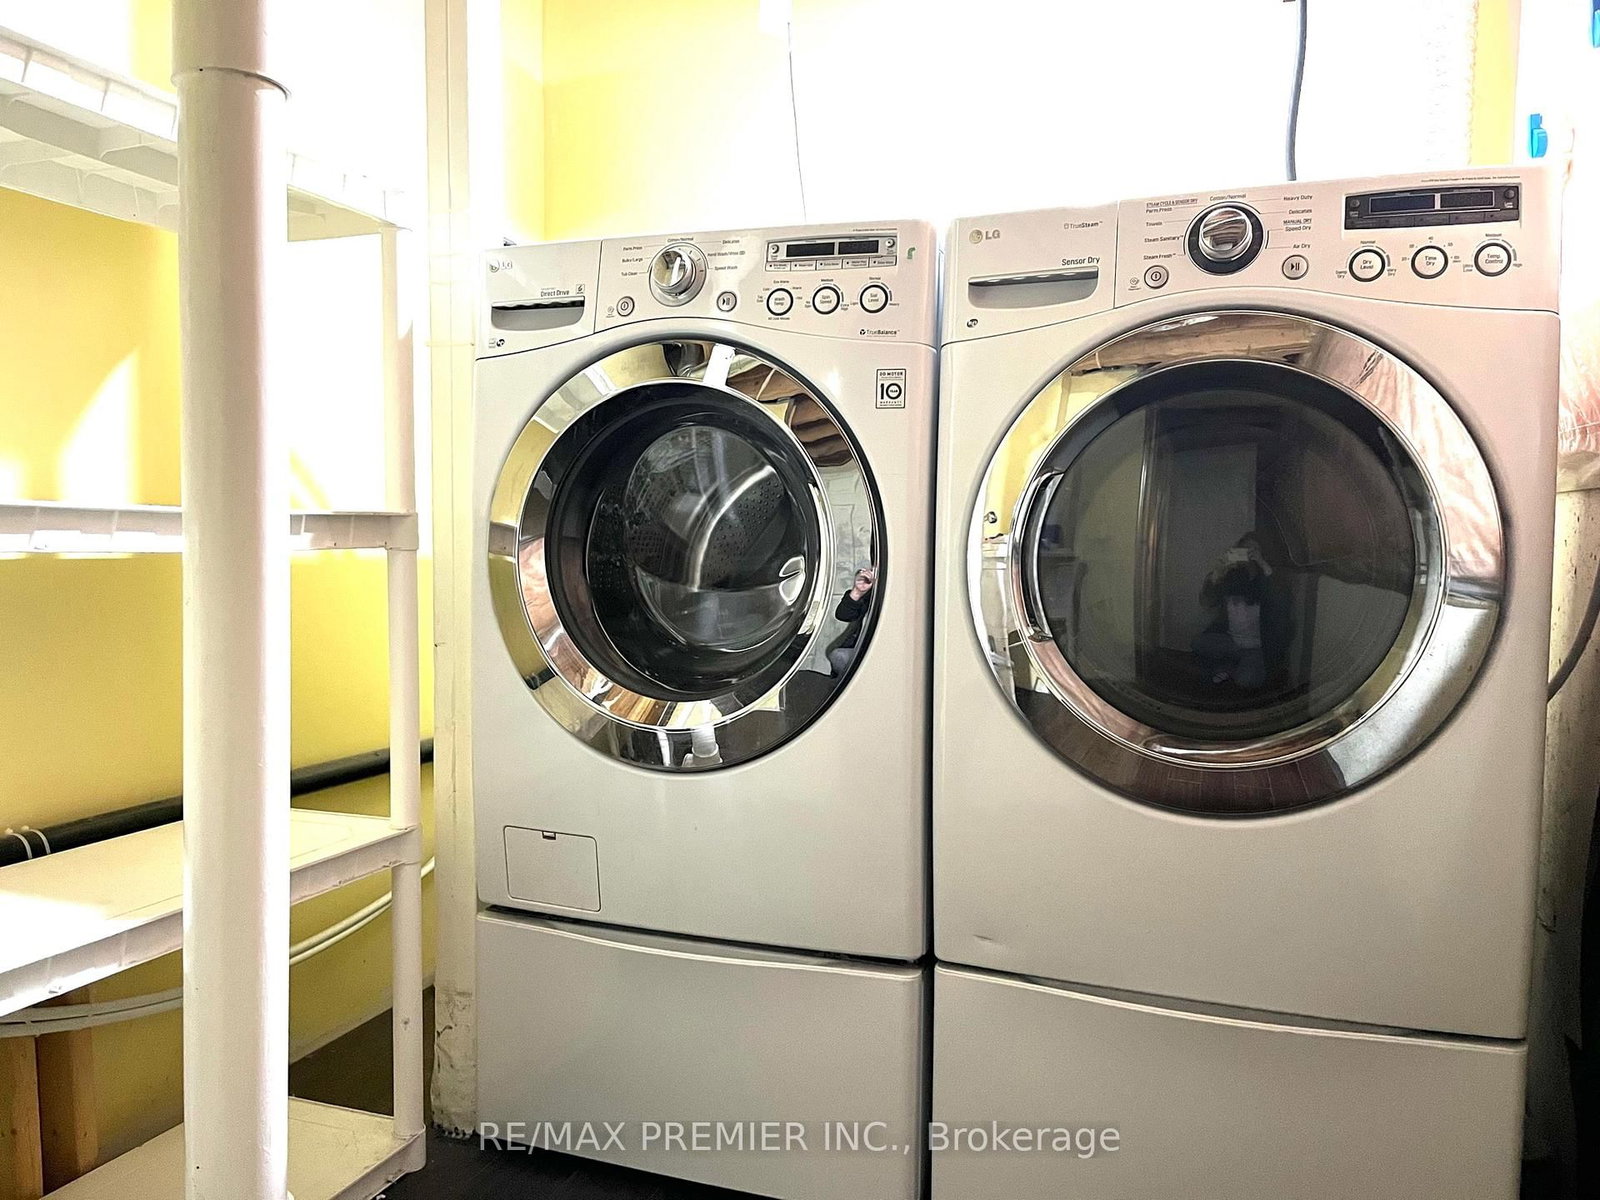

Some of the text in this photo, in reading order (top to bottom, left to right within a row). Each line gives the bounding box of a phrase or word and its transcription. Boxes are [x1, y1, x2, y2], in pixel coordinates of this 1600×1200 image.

[985, 230, 1000, 240] LG
[1062, 256, 1100, 266] Sensor Dry
